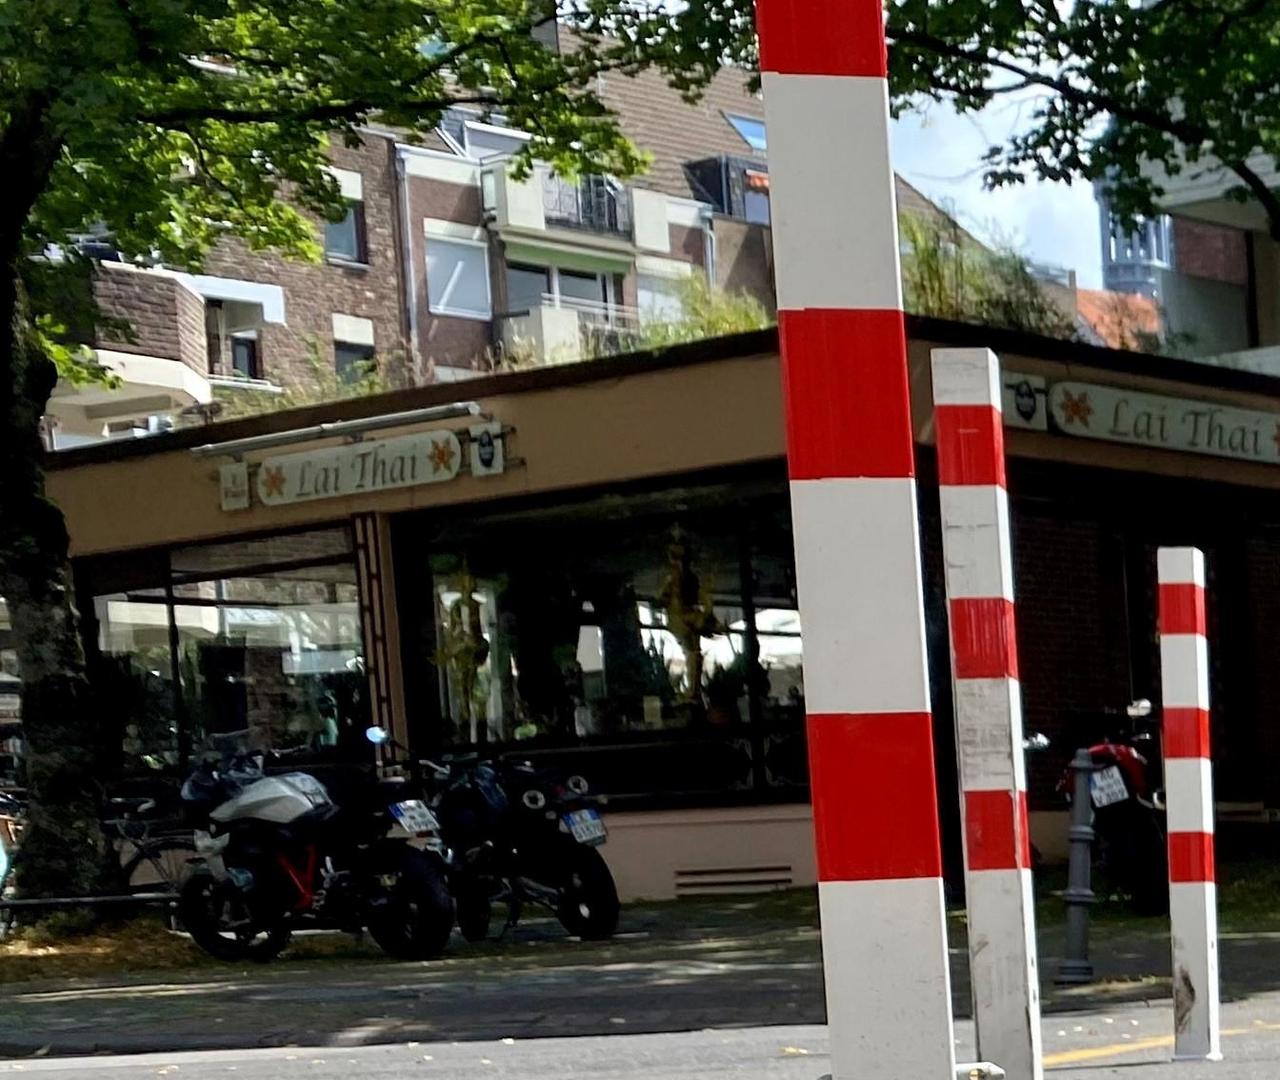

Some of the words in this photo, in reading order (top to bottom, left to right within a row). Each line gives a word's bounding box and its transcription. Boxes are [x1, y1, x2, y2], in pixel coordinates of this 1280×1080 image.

[1108, 399, 1169, 442] Lai
[1181, 408, 1264, 456] Thai
[295, 460, 341, 497] Lai
[350, 443, 419, 488] Thai
